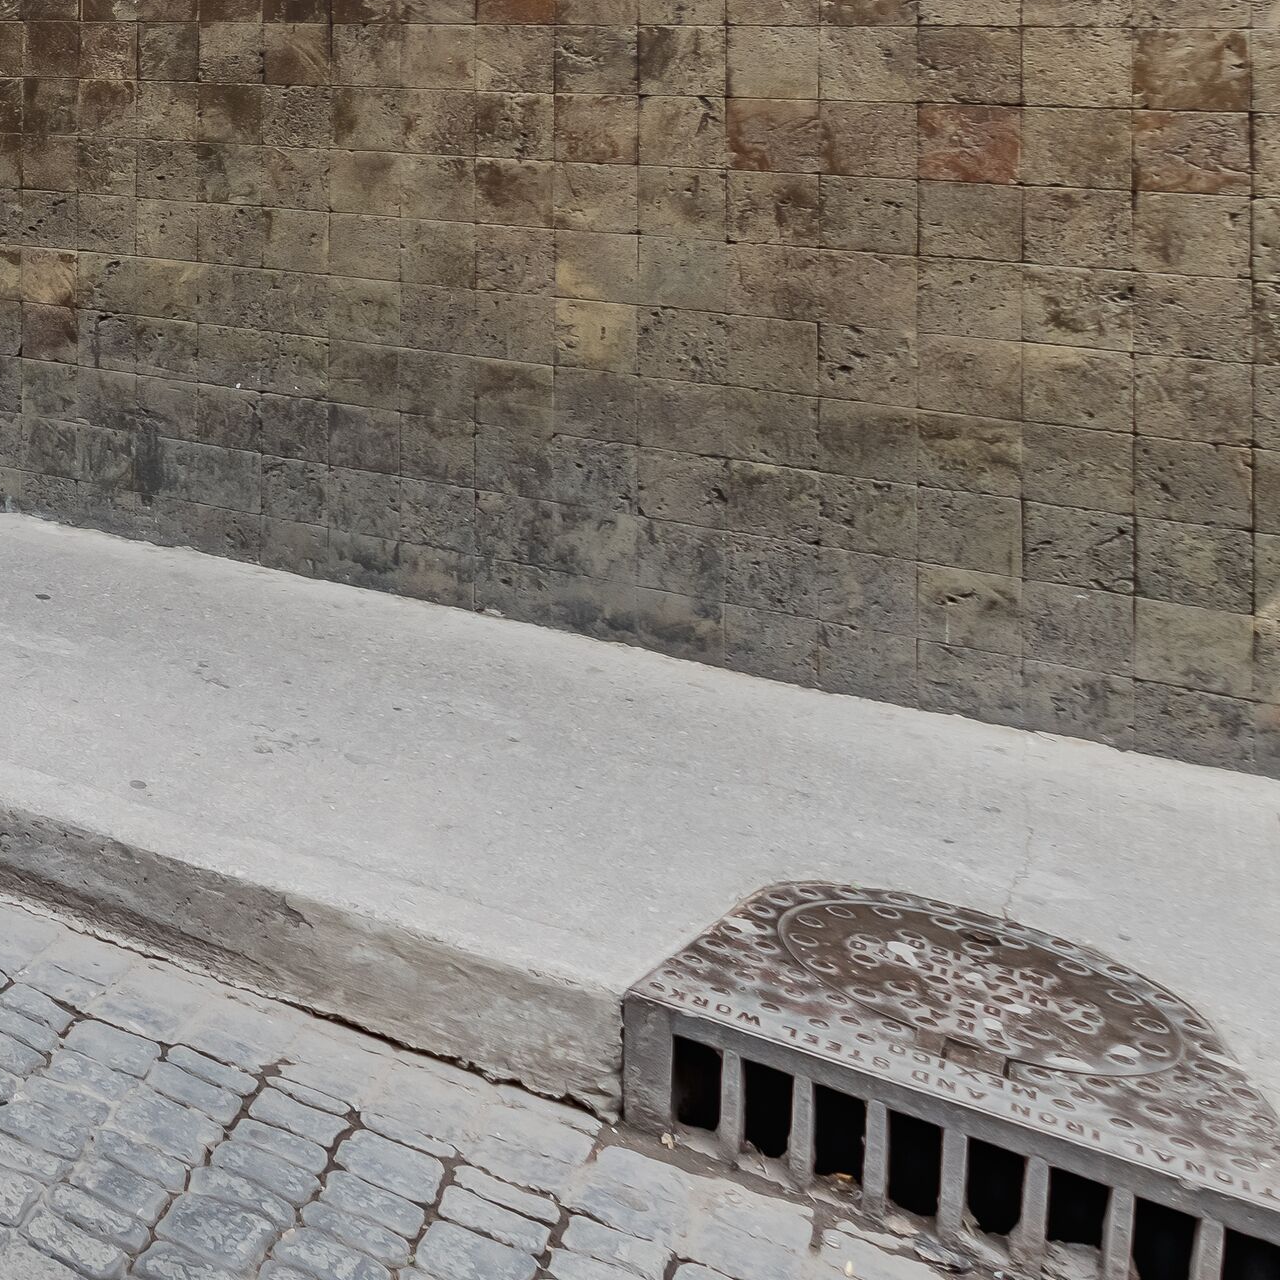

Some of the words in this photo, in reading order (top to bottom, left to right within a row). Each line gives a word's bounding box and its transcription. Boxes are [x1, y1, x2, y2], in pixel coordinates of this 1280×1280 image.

[648, 980, 762, 1028] WORKS
[781, 1024, 891, 1069] STEEL
[888, 1043, 1038, 1101] MEXICO
[911, 1069, 989, 1101] AND
[1011, 1102, 1102, 1142] IRON
